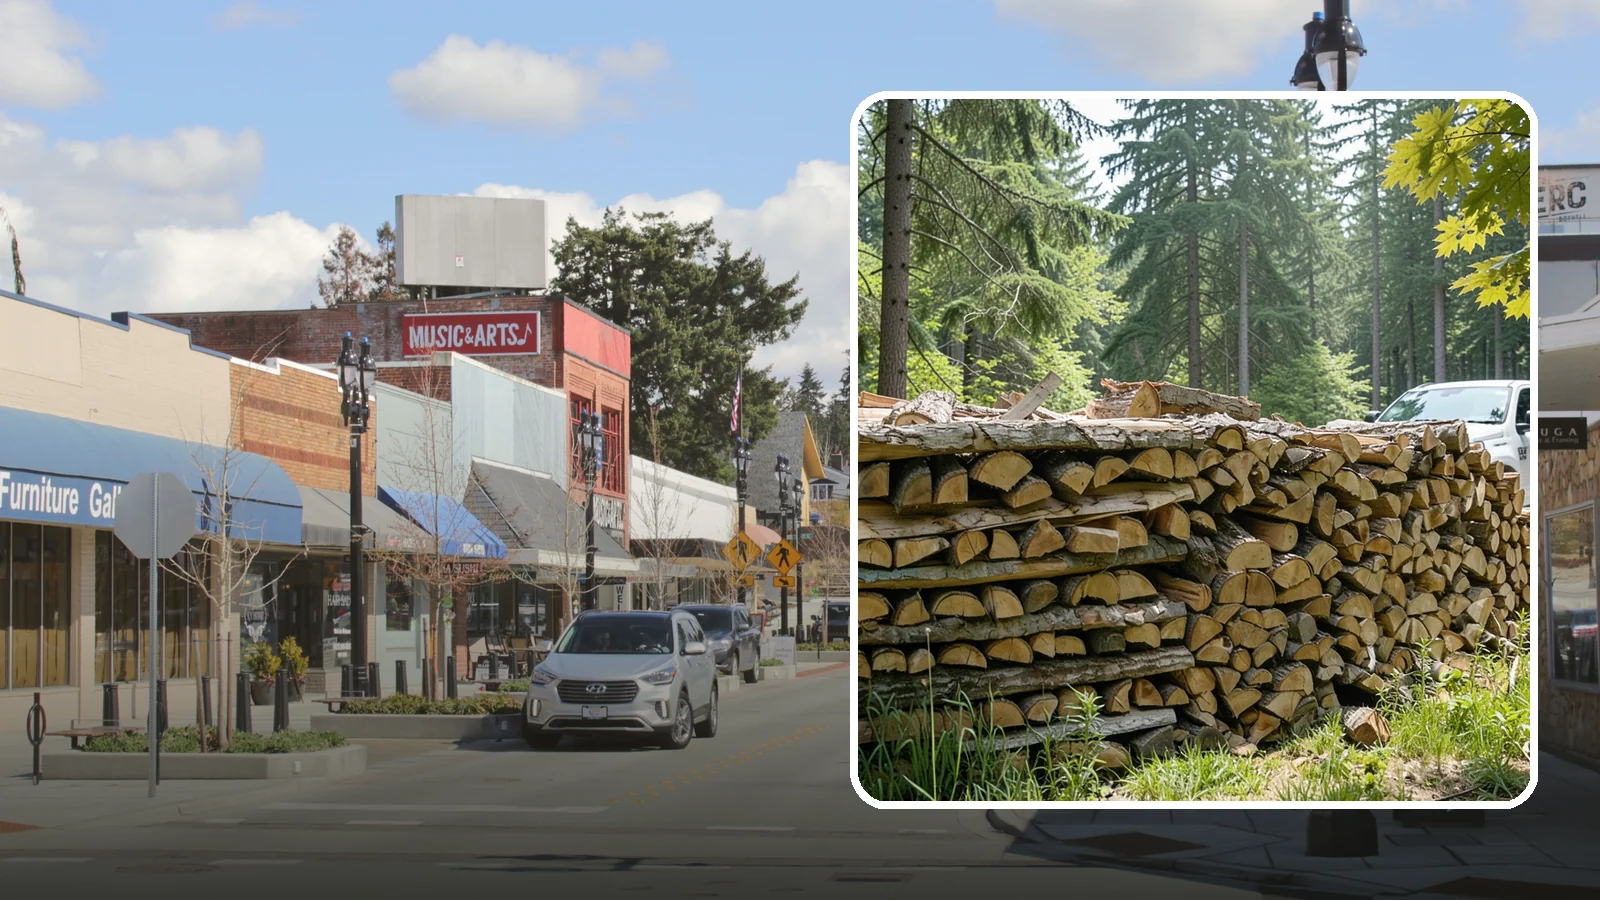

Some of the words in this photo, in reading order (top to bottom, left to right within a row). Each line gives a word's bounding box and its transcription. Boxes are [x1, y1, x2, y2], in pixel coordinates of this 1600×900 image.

[409, 323, 519, 349] MUSIC&ARTS
[1540, 427, 1577, 437] UGA
[0, 471, 79, 515] Furniture
[89, 482, 122, 519] Gal
